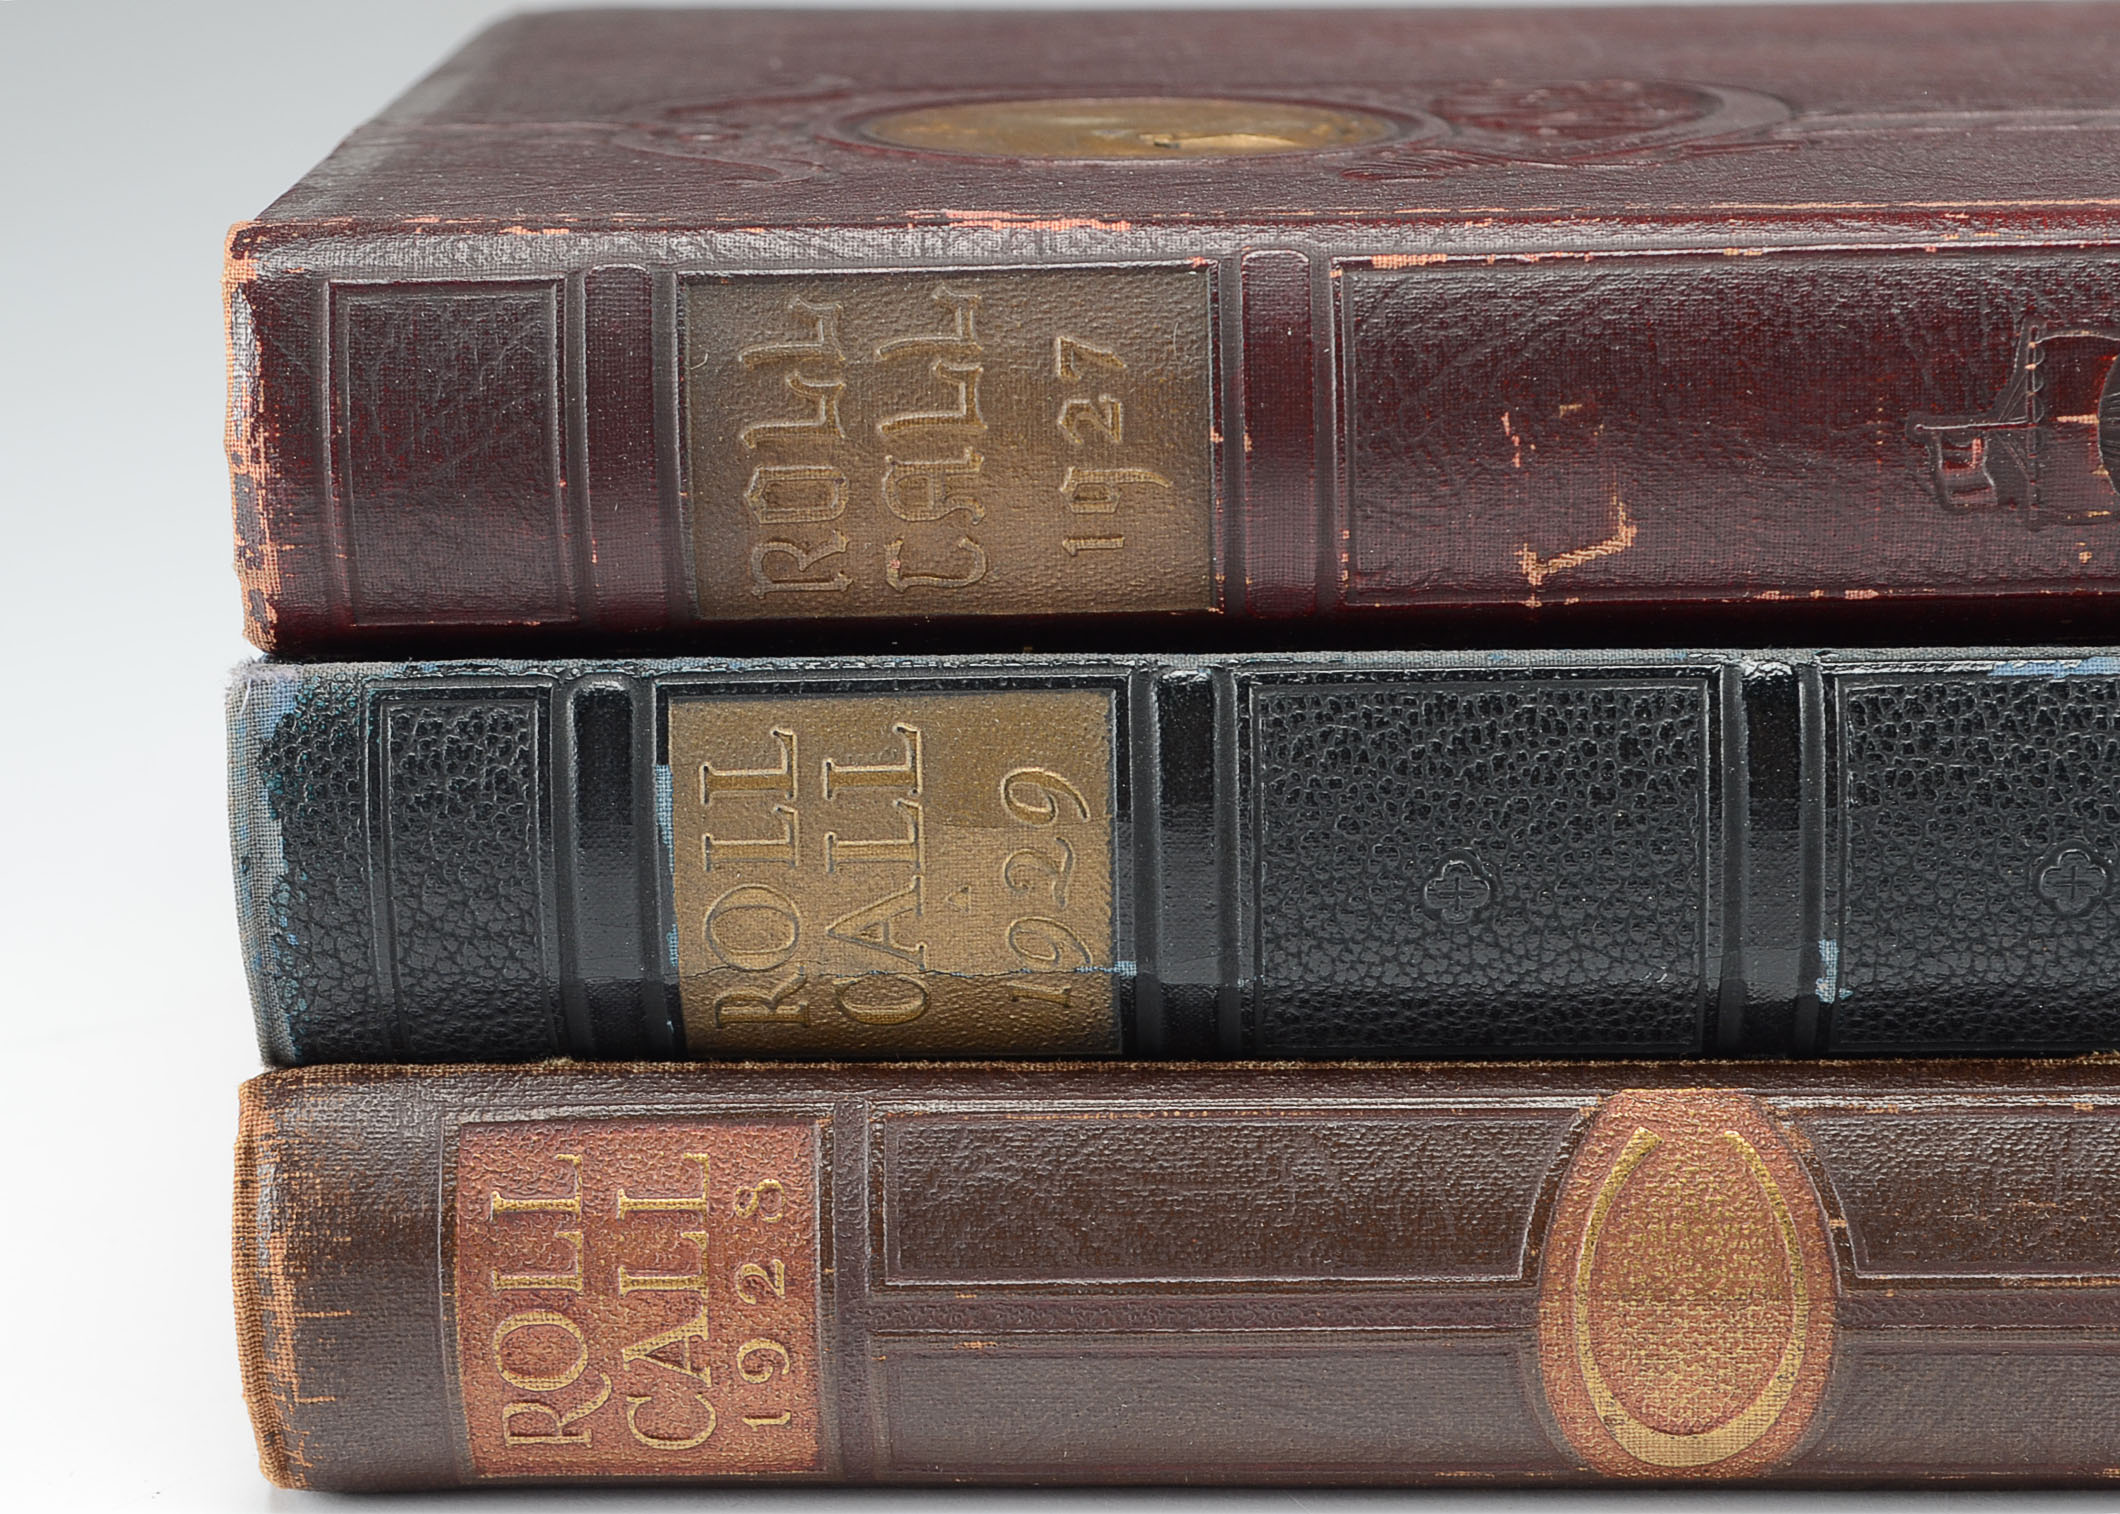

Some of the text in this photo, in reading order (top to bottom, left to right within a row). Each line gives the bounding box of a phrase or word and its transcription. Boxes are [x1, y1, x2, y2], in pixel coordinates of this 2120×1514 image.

[738, 301, 854, 598] ROLL
[877, 284, 987, 592] CALL
[1056, 335, 1173, 556] 1927
[700, 726, 809, 1029] ROLL
[822, 722, 929, 1025] CALL
[1001, 767, 1092, 1007] 1929
[491, 1153, 612, 1447] ROLL
[617, 1152, 717, 1450] CALL
[734, 1179, 791, 1431] 1928
